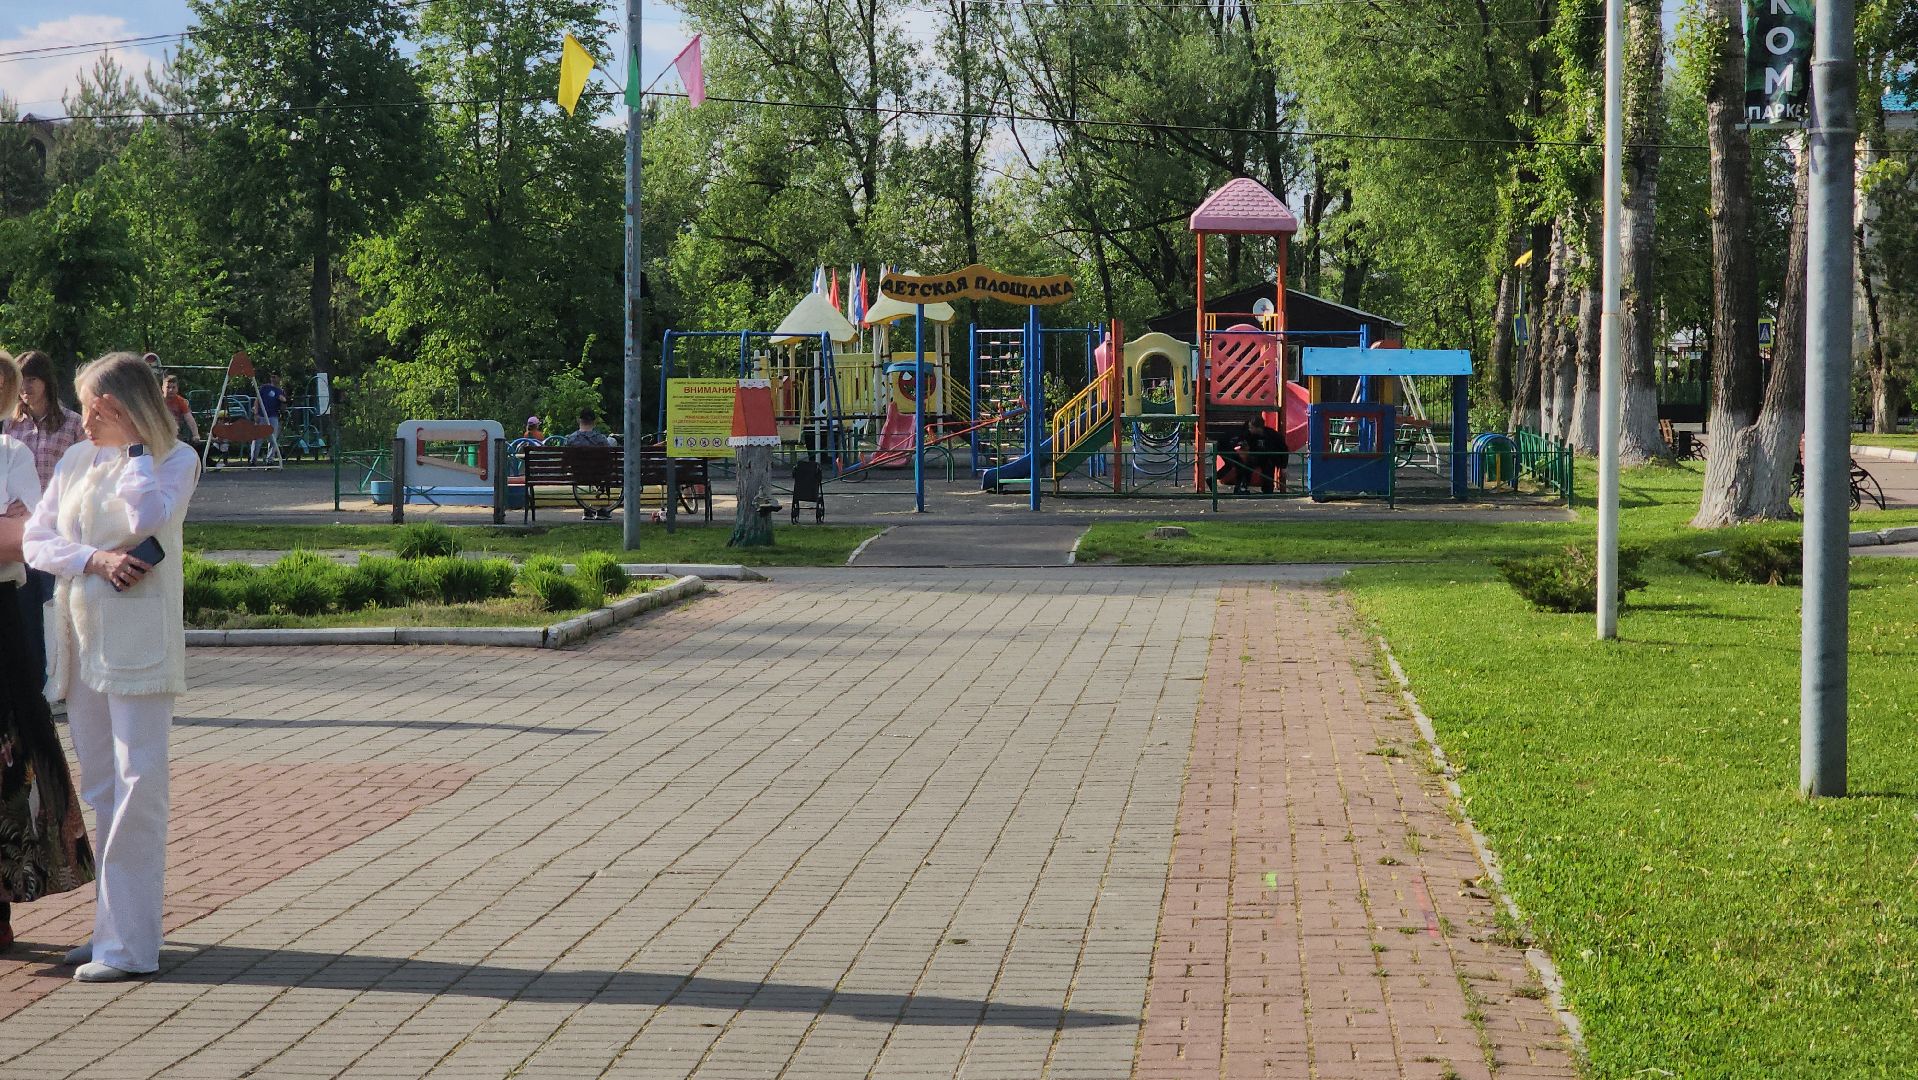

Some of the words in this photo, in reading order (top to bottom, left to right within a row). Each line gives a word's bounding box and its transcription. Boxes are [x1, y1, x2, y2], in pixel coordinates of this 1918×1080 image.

[881, 276, 969, 297] ДЕТСКАЯ
[974, 275, 1075, 299] ПЛОЩАДКА
[683, 386, 737, 394] ВНИМАНИЕ
